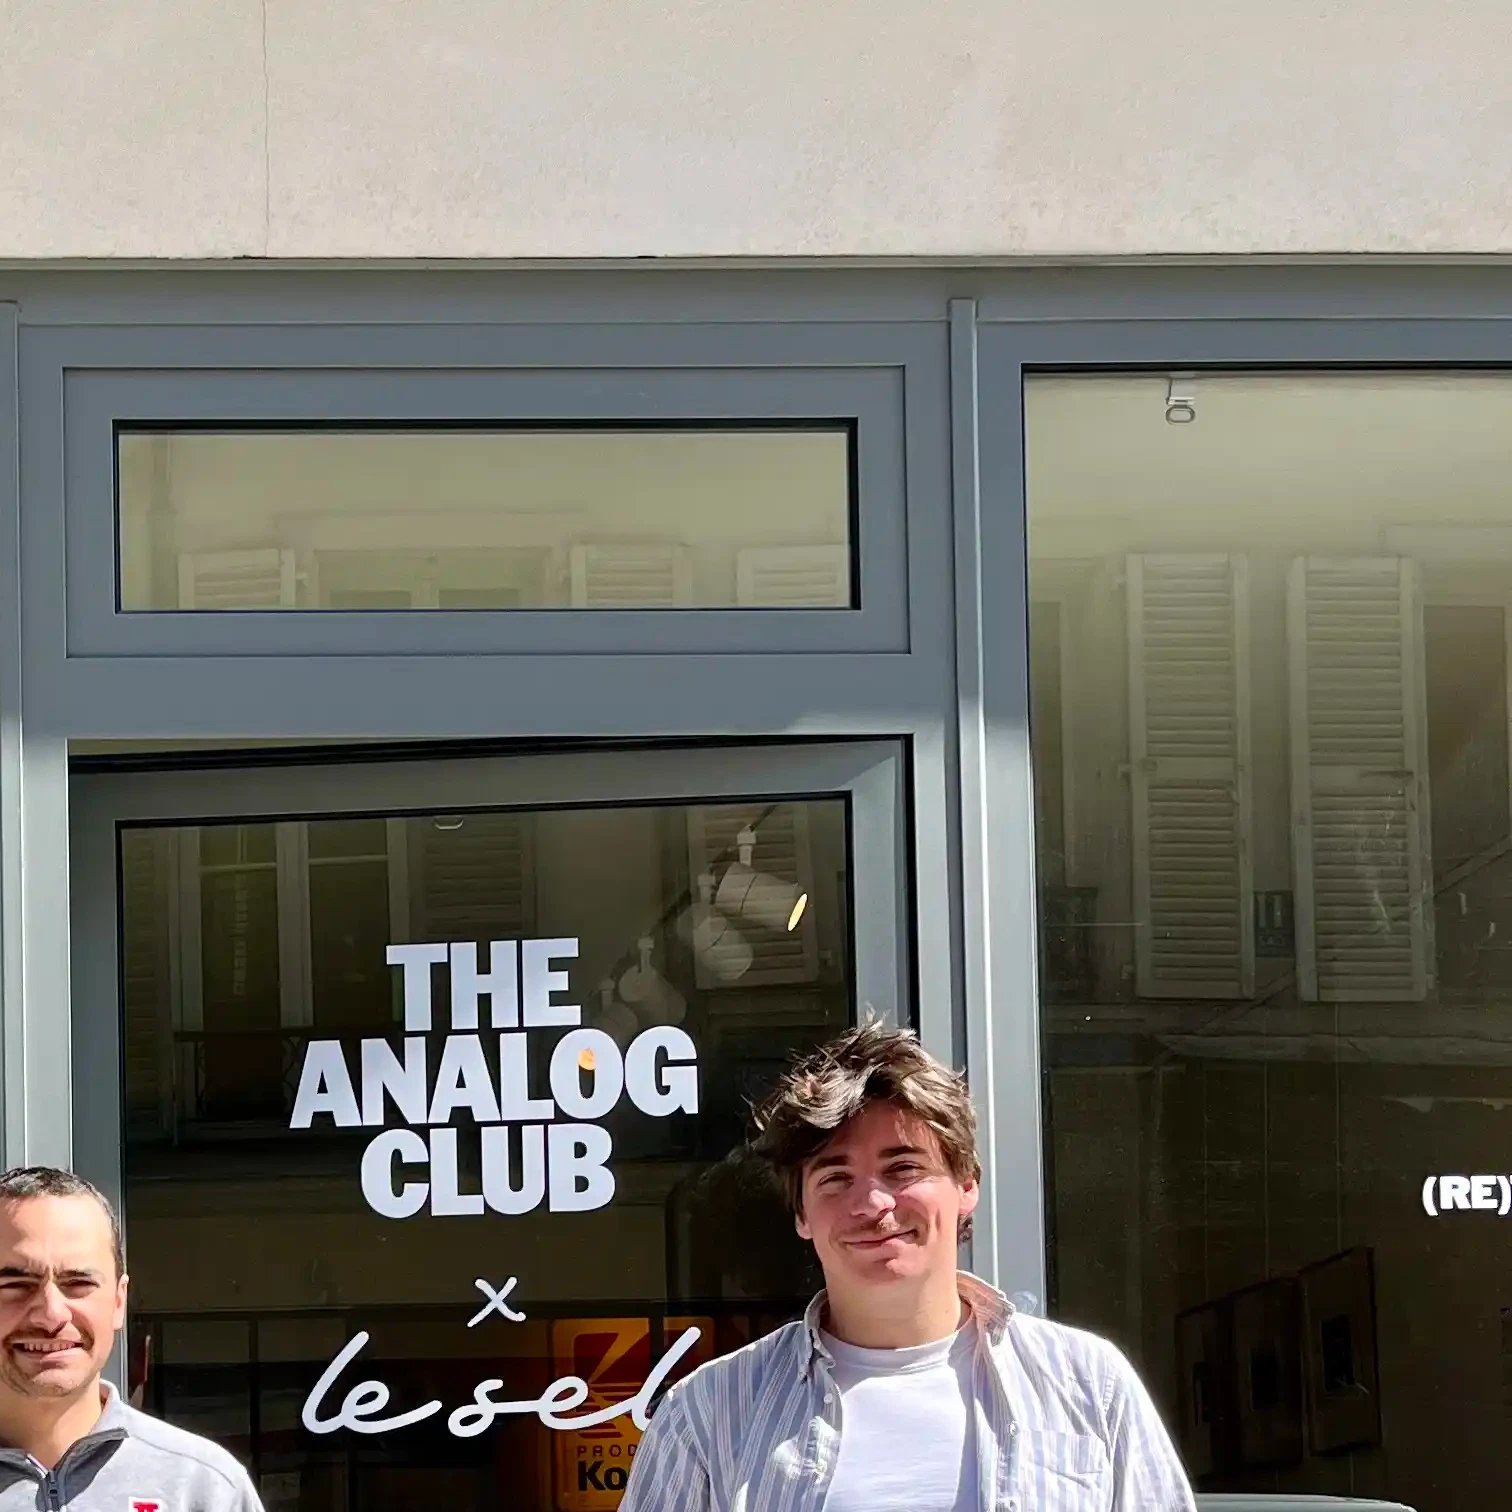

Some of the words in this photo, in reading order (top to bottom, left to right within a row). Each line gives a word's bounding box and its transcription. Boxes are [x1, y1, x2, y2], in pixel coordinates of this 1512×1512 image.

[386, 938, 582, 1032] THE
[289, 1026, 698, 1129] ANALOG
[361, 1123, 616, 1219] CLUB
[1422, 1174, 1512, 1216] (RE)
[301, 1331, 442, 1434] le
